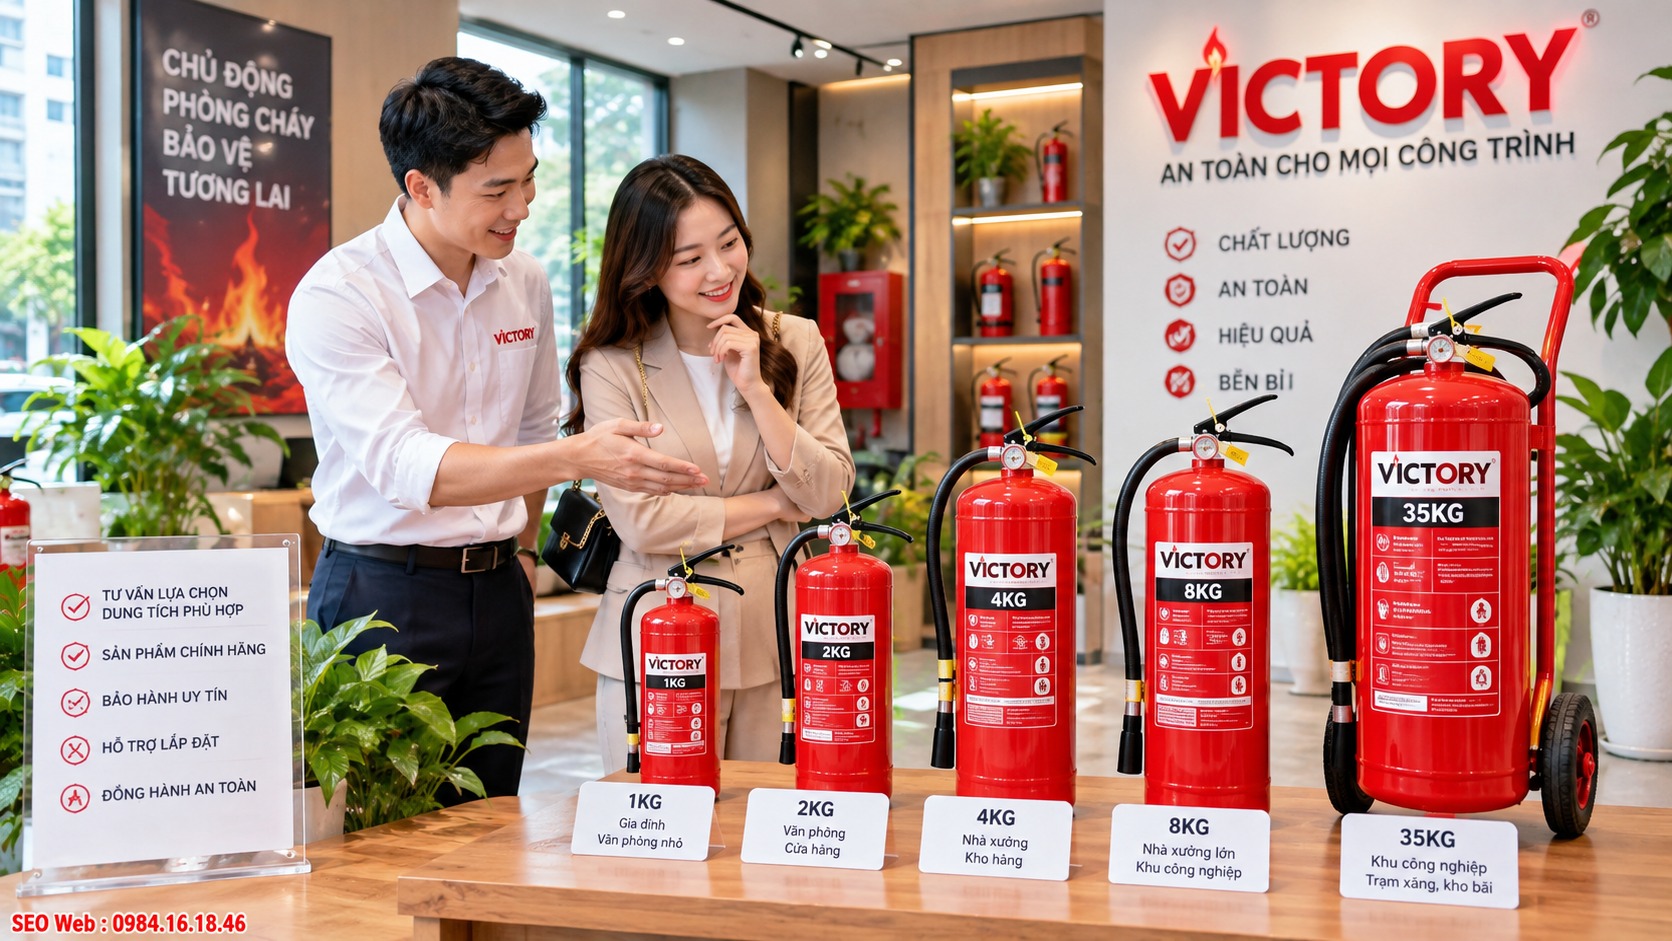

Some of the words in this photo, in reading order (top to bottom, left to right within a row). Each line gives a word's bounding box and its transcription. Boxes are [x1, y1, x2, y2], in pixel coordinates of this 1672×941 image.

[162, 48, 217, 83] CHỦ
[223, 60, 293, 100] ĐỘNG
[1149, 26, 1577, 142] VICTORY
[163, 88, 249, 128] PHÒNG
[254, 106, 315, 140] CHÁY
[163, 124, 216, 162] BẢO
[221, 135, 253, 173] VỆ
[1160, 162, 1193, 184] AN
[1202, 152, 1267, 180] TOÀN
[1276, 151, 1331, 175] CHO
[1340, 147, 1388, 175] MỌI
[1398, 136, 1478, 166] CÔNG
[1487, 129, 1575, 160] TRÌNH
[162, 169, 250, 206] TƯƠNG
[255, 181, 291, 211] LAI
[1218, 226, 1271, 251] CHẤT
[1278, 229, 1350, 252] LƯỢNG
[1218, 281, 1246, 298] AN
[1252, 274, 1308, 296] TOÀN
[493, 329, 535, 345] VICTORY
[1219, 322, 1264, 348] HIỆU
[1270, 319, 1313, 344] QUẢ
[1378, 458, 1491, 485] VICTORY
[1402, 502, 1464, 523] 35KG
[969, 558, 1051, 578] VICTORY
[1160, 548, 1246, 569] VICTORY
[102, 588, 122, 601] TƯ
[158, 587, 185, 602] LỰA
[189, 586, 228, 601] CHỌN
[991, 592, 1027, 607] 4KG
[1184, 583, 1222, 600] 8KG
[102, 607, 143, 620] DUNG
[147, 604, 179, 618] TÍCH
[215, 603, 244, 618] HỢP
[804, 619, 870, 635] VICTORY
[102, 645, 131, 661] SẢN
[180, 643, 223, 658] CHÍNH
[822, 646, 851, 658] 2KG
[648, 657, 702, 670] VICTORY
[664, 678, 686, 688] 1KG
[102, 690, 133, 707] BẢO
[137, 690, 178, 705] HÀNH
[182, 691, 201, 703] UY
[205, 687, 228, 702] TÍN
[102, 737, 124, 754] HỖ
[127, 738, 157, 754] TRỢ
[192, 734, 220, 750] ĐẶT
[149, 783, 191, 798] HÀNH
[194, 783, 214, 796] AN
[219, 778, 257, 793] TOÀN
[629, 793, 662, 810] 1KG
[797, 800, 834, 817] 2KG
[619, 817, 637, 829] Gia
[976, 808, 1016, 826] 4KG
[1168, 817, 1210, 836] 8KG
[1400, 828, 1456, 848] 35KG
[785, 842, 808, 855] Cửa
[1215, 846, 1235, 859] lớn
[965, 852, 989, 865] Kho
[1371, 855, 1398, 868] Khu
[1402, 857, 1436, 873] công
[1439, 860, 1488, 877] nghiệp
[1136, 861, 1160, 873] Khu
[1164, 862, 1195, 878] công
[1199, 865, 1242, 881] nghiệp
[1365, 874, 1400, 889] Trạm
[1443, 879, 1468, 893] kho
